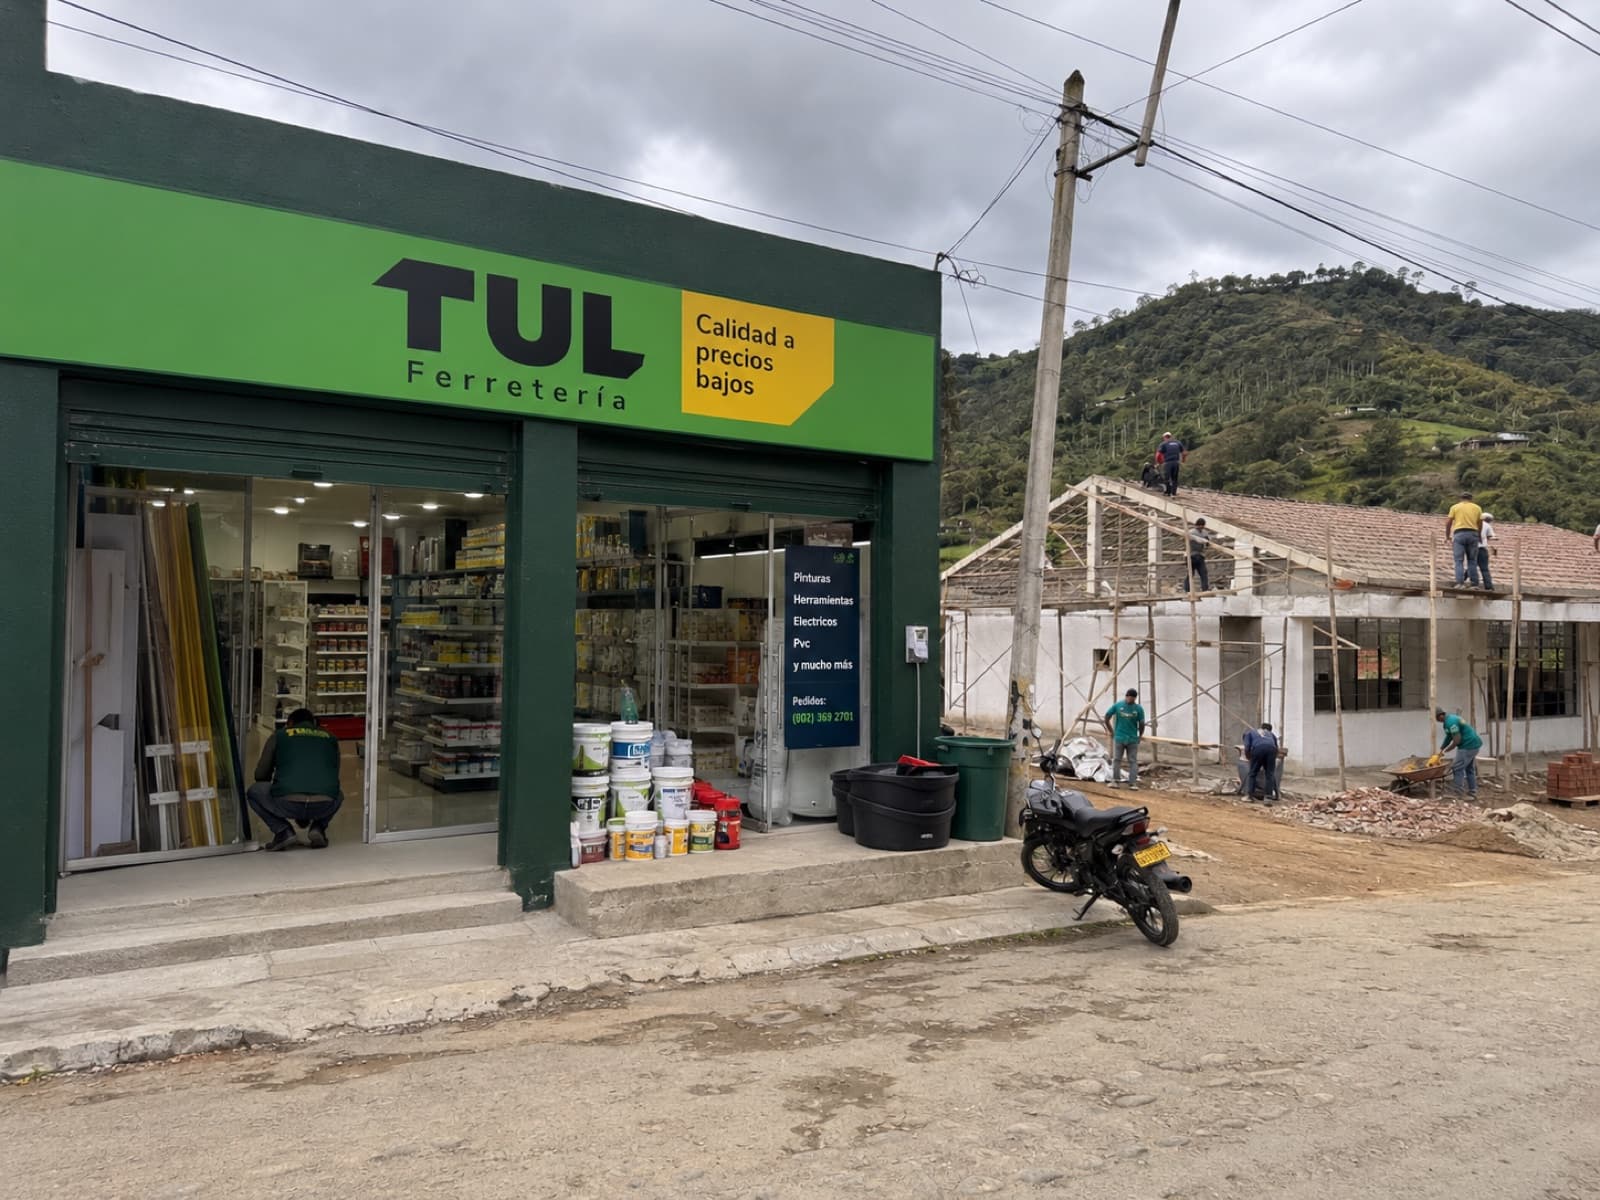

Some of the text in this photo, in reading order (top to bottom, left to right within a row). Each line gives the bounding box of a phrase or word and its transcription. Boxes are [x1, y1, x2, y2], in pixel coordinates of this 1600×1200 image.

[372, 257, 645, 380] TUL
[696, 313, 795, 350] Calidad a
[696, 343, 774, 372] precios
[407, 359, 626, 411] Ferretería
[696, 368, 755, 397] bajos
[793, 572, 832, 584] Pinturas
[793, 594, 854, 606] Herramientas
[793, 638, 811, 649] Pvc
[792, 659, 854, 672] y mucho más
[792, 695, 827, 707] Pedidos:
